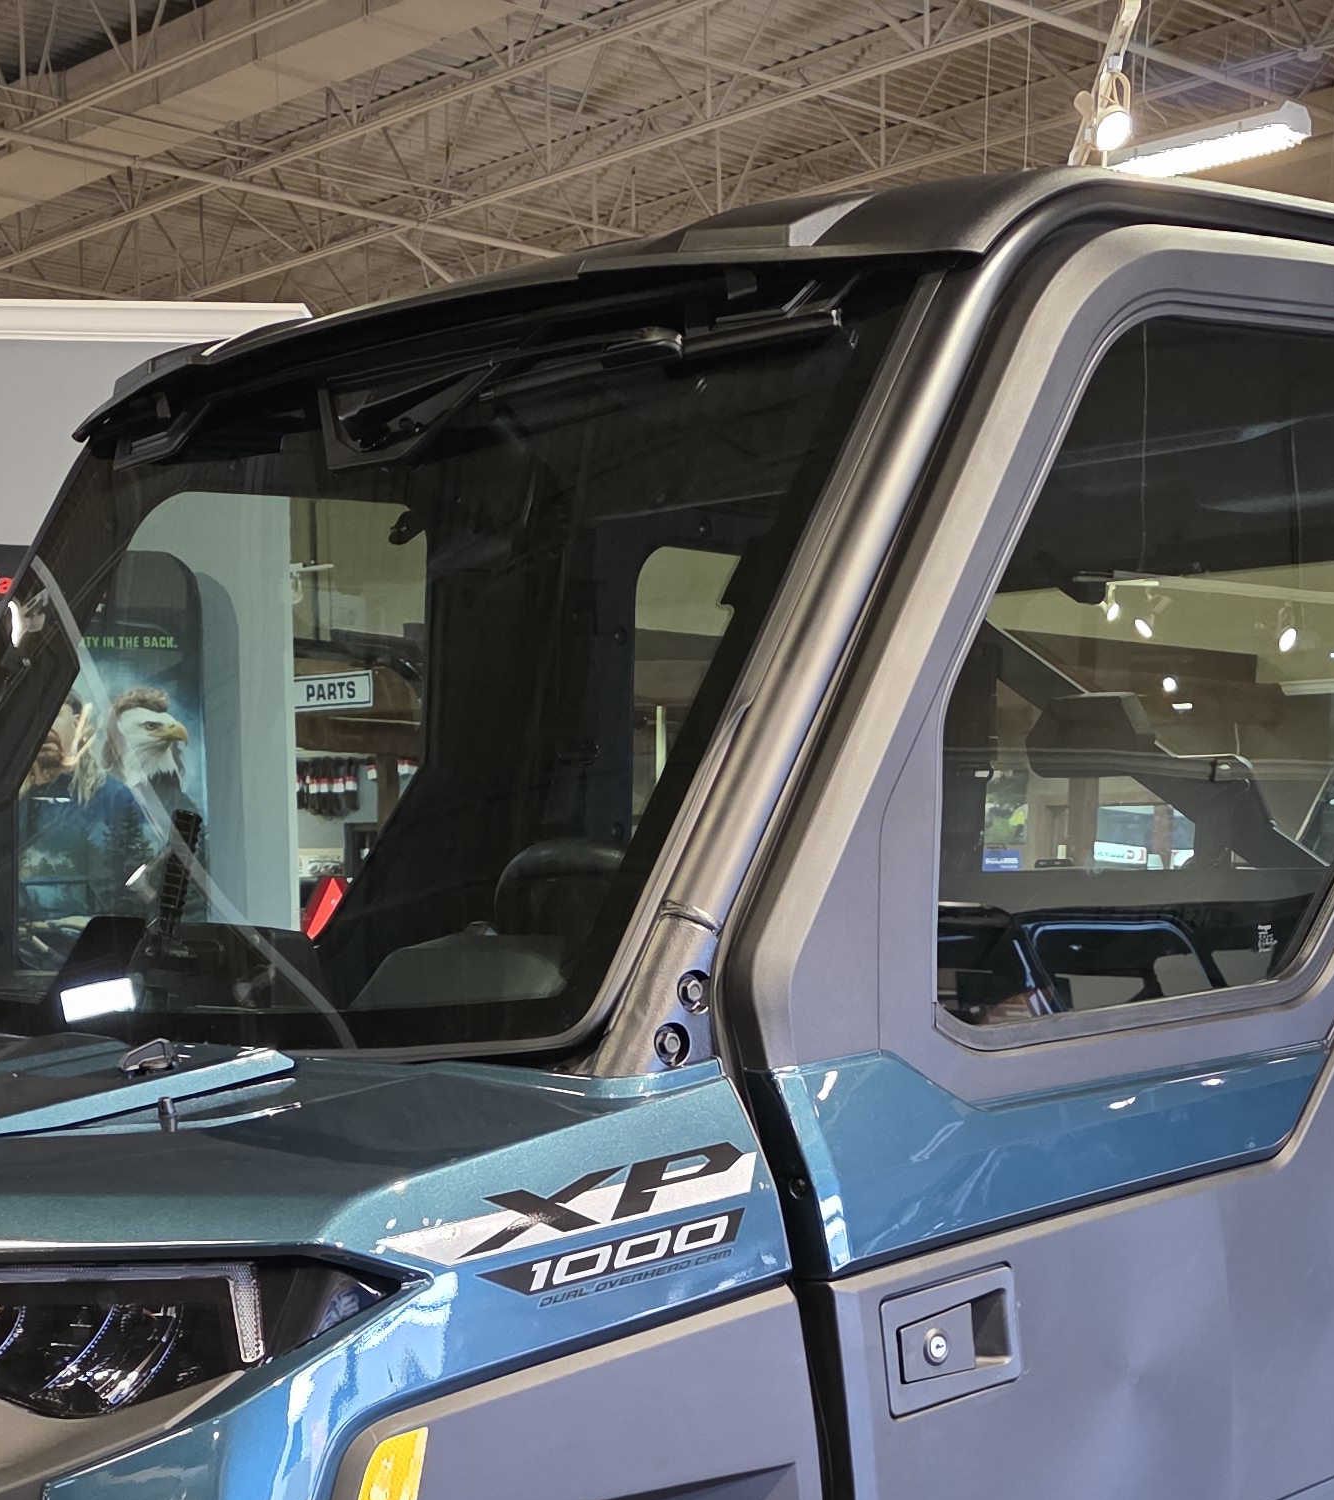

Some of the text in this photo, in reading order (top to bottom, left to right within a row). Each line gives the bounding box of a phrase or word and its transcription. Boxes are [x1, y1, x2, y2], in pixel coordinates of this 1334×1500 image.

[103, 636, 115, 648] IN
[118, 636, 140, 649] THE
[143, 636, 178, 649] BACK.
[306, 680, 356, 702] PARTS
[455, 1141, 745, 1260] XP
[528, 1214, 730, 1292] 1000
[538, 1248, 734, 1309] DUAL OVERHEAD CAM
